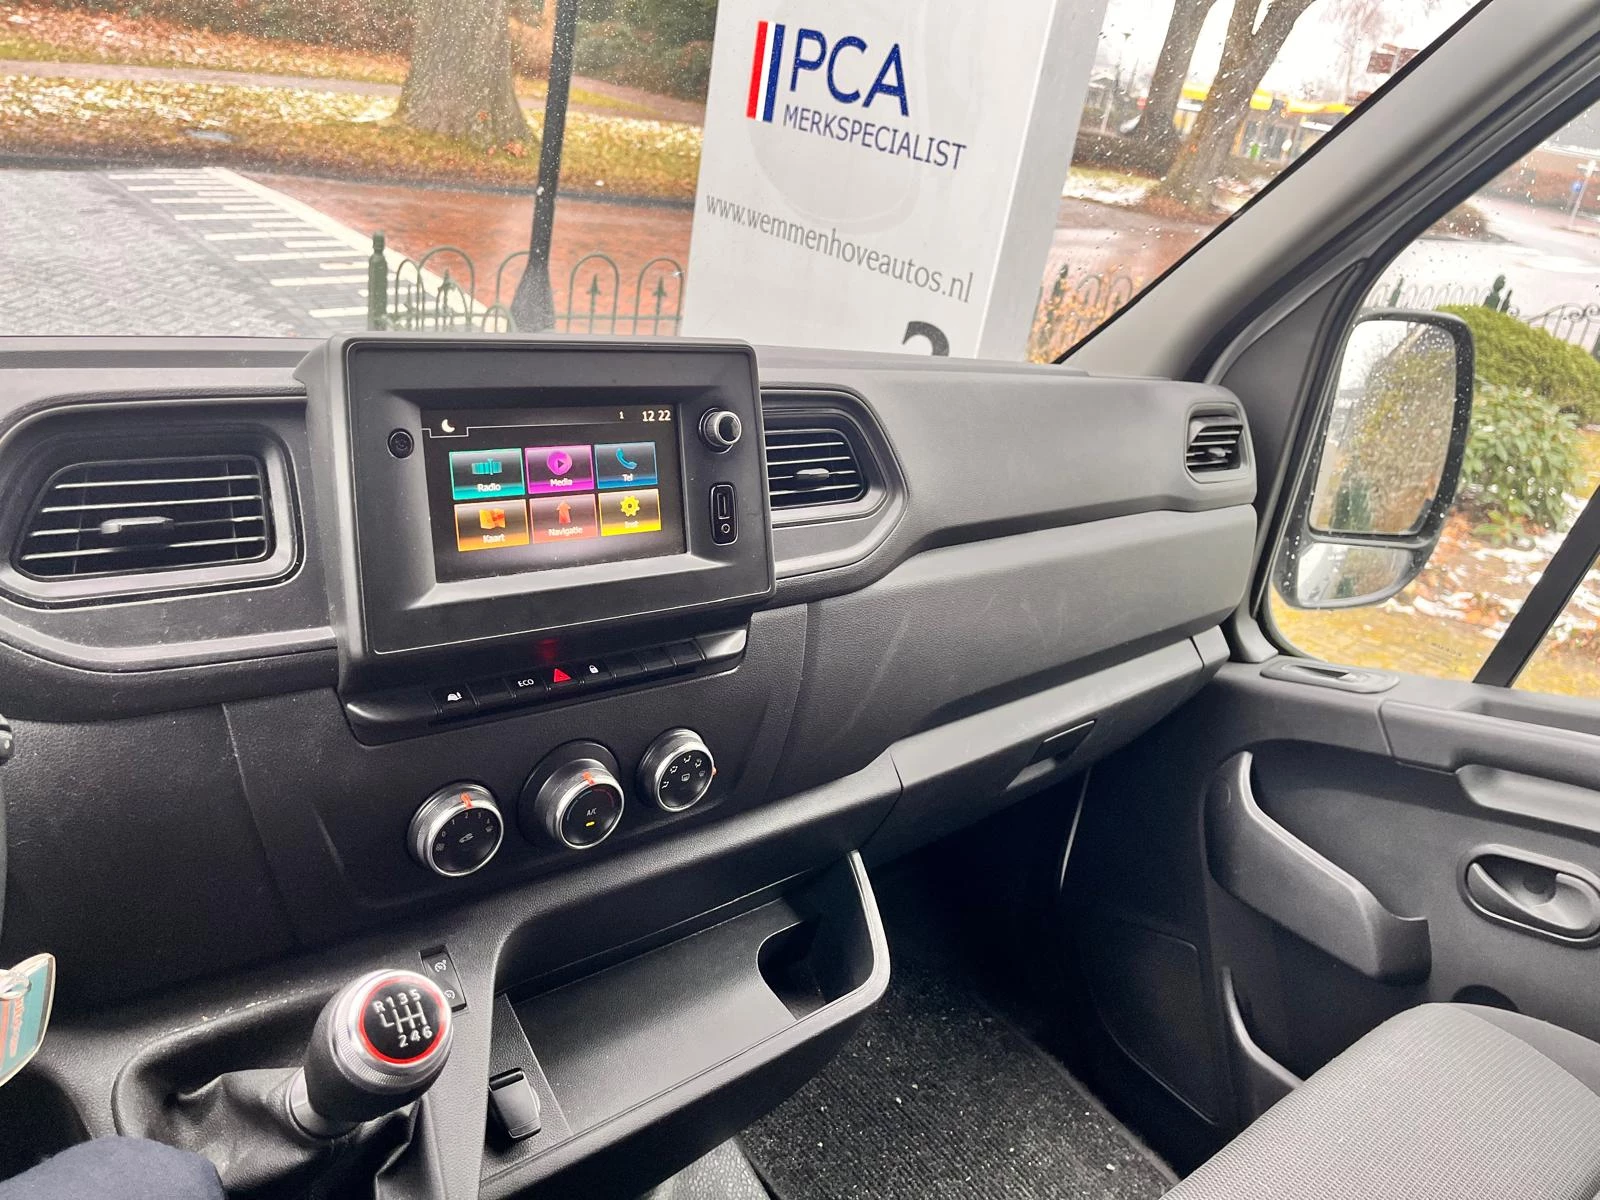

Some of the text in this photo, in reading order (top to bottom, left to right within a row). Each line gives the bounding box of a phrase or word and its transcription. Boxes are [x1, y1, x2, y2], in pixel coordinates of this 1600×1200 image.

[788, 27, 911, 118] PCA
[782, 103, 968, 171] MERKSPECIALIST
[705, 193, 975, 305] www.wemmenhoveautos.nl
[549, 477, 573, 487] Media
[621, 472, 634, 482] Tel
[477, 482, 502, 493] Radio
[547, 526, 583, 537] Navigatie
[482, 533, 505, 543] Kaart
[518, 678, 535, 688] ECO
[372, 989, 421, 1013] R 1 3 5
[398, 1025, 433, 1048] 2 4 6
